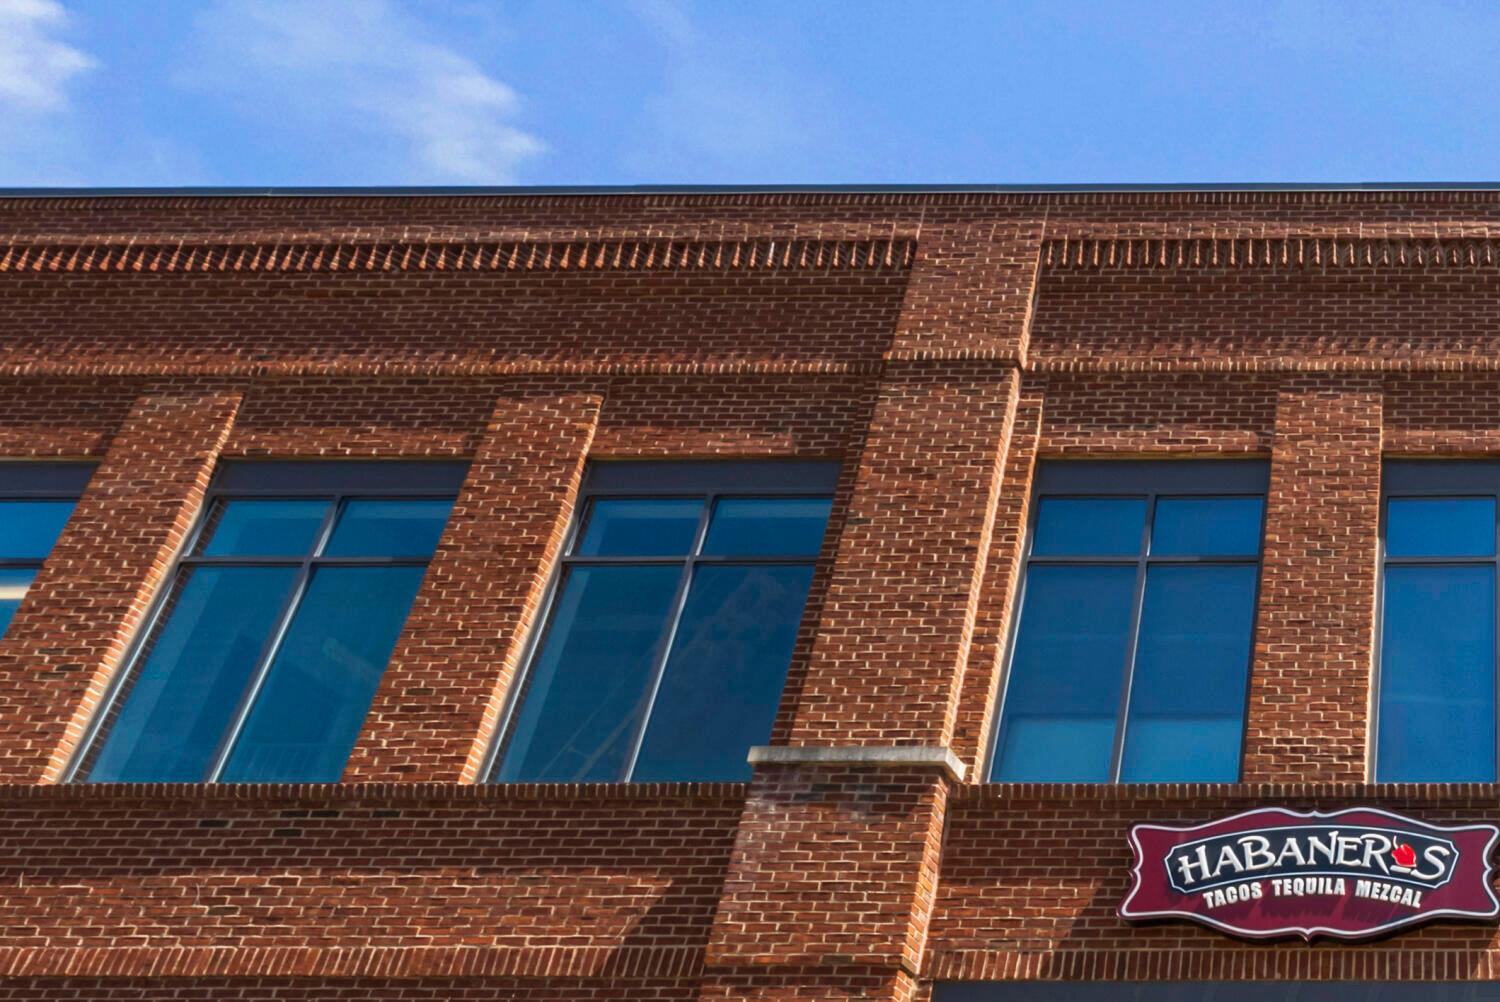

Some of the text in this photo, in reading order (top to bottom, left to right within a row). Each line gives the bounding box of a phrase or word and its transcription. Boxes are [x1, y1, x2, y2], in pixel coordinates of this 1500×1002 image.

[1203, 877, 1422, 909] TACOS TEQUILA MEZCAL
